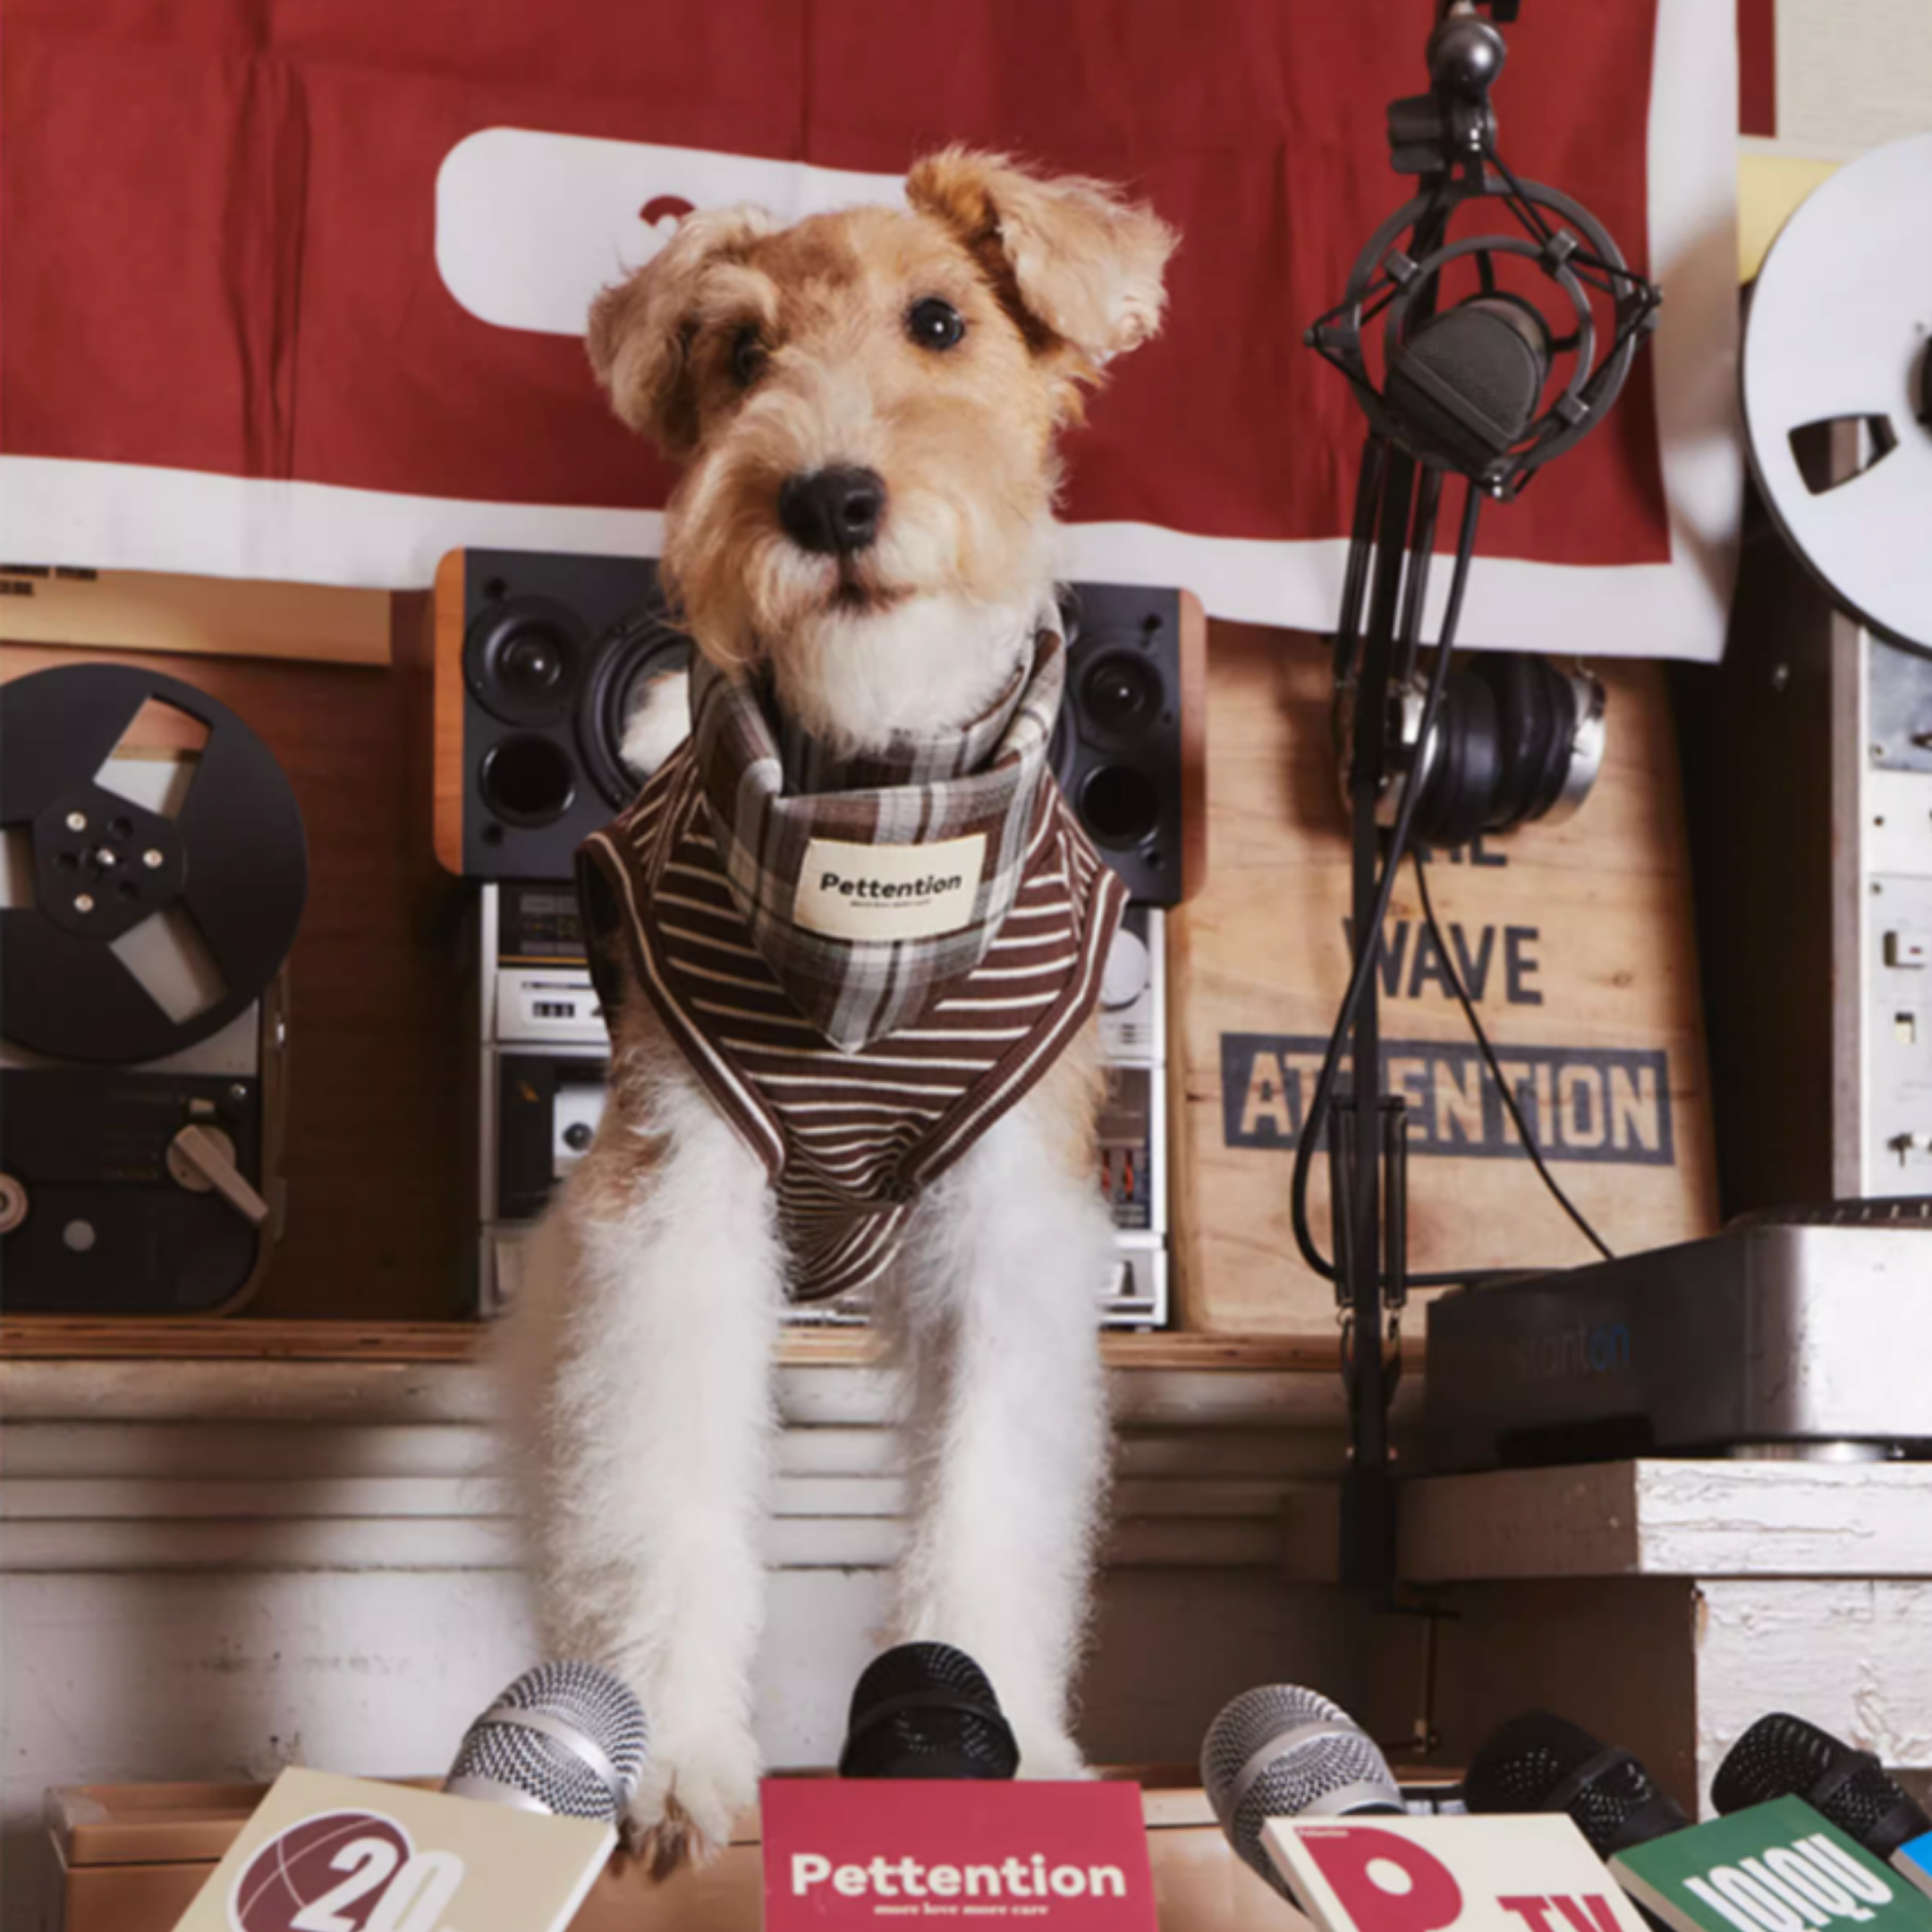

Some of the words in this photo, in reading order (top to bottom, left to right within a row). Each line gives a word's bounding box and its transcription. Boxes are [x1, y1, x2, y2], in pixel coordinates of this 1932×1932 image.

[819, 872, 962, 898] Pettention
[1341, 915, 1545, 1006] WAVE
[1240, 1052, 1660, 1150] ATENTION
[790, 1852, 1128, 1898] Pettention
